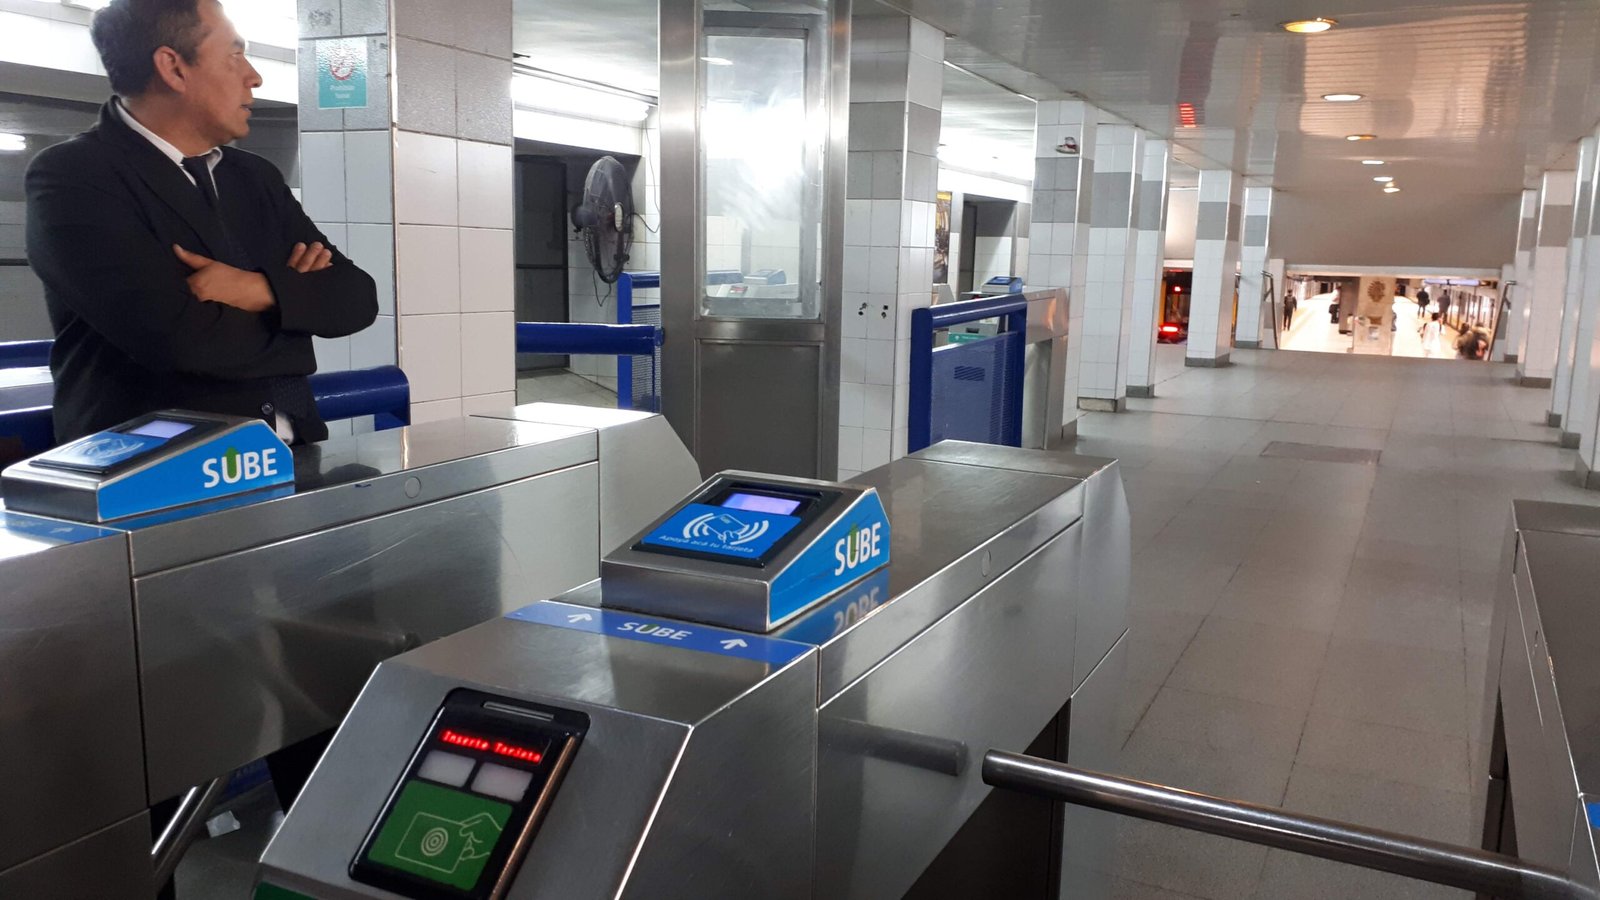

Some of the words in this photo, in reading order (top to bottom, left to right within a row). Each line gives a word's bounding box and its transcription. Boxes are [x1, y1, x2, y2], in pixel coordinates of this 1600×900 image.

[202, 447, 278, 488] SUBE
[722, 544, 754, 554] tarjeta
[834, 521, 881, 576] SUBE
[616, 621, 693, 640] SUBE
[494, 741, 542, 763] Tarjeta
